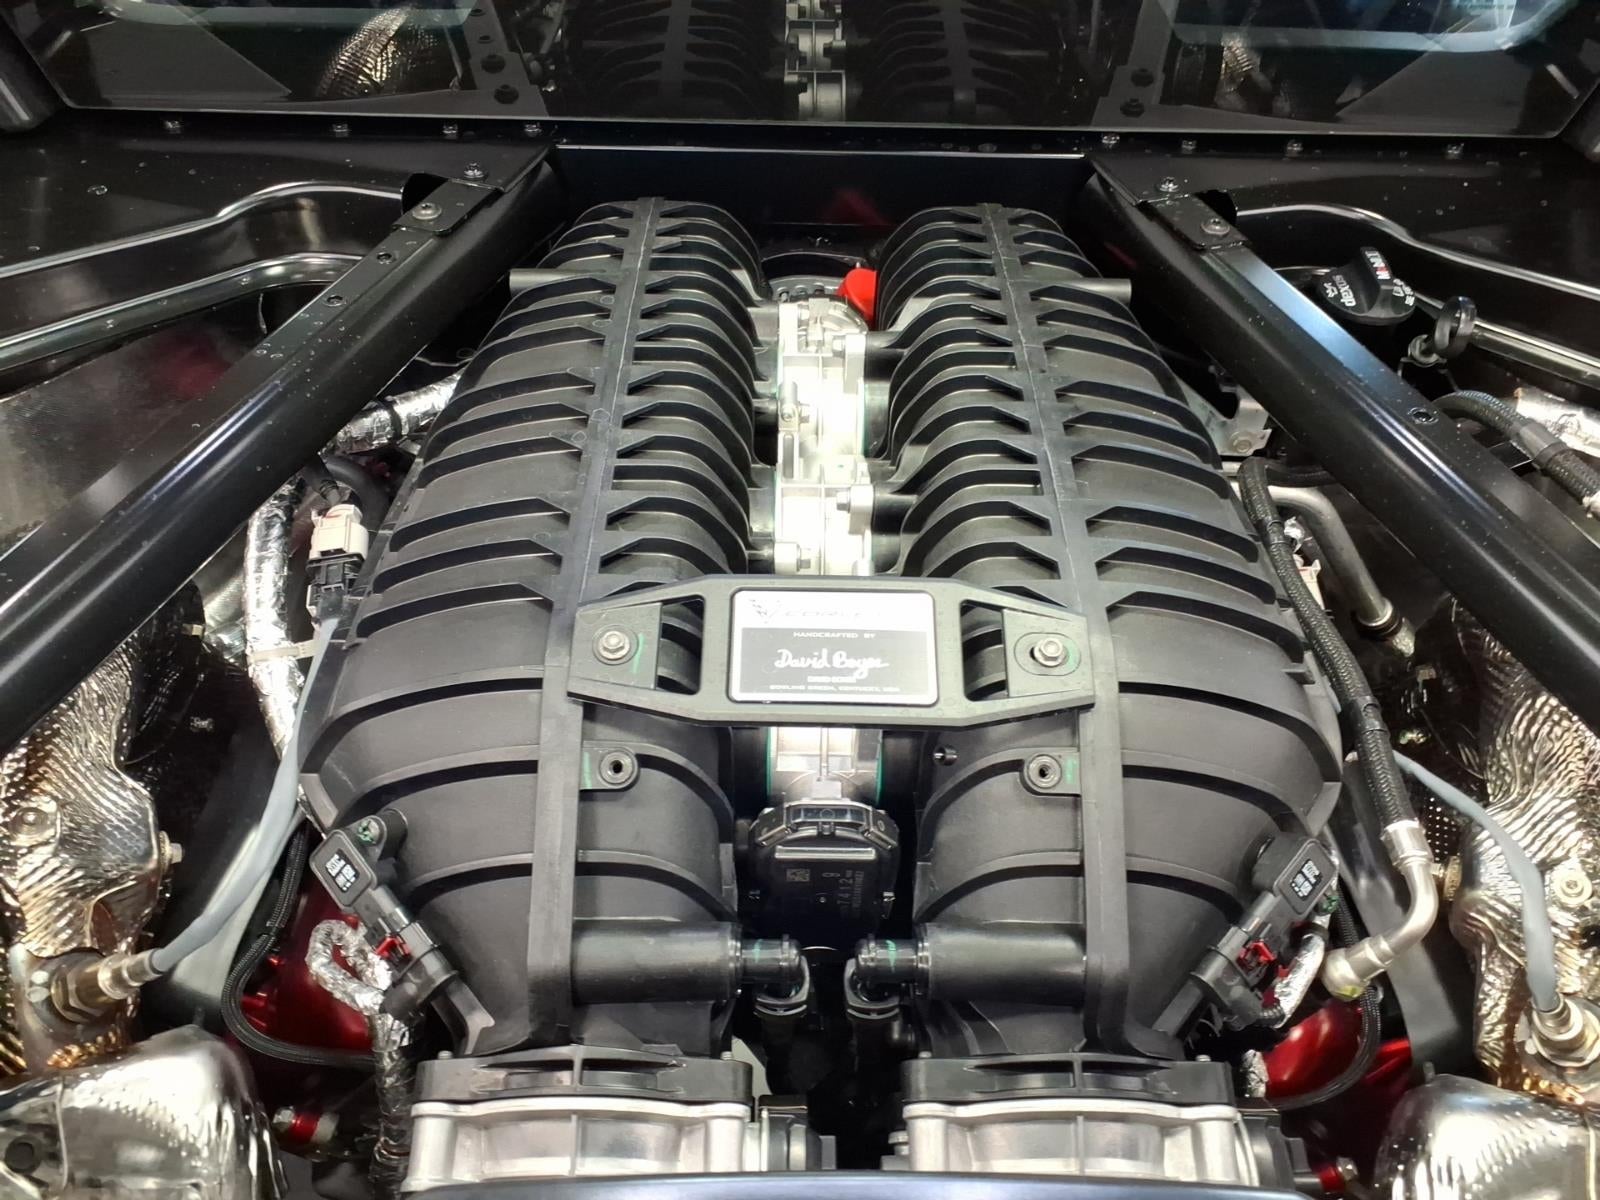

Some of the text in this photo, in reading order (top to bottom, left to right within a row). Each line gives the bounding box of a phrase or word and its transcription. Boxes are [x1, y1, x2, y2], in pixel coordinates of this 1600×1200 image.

[1332, 275, 1356, 307] dexos
[793, 631, 858, 639] HANDCRAFTED
[774, 648, 831, 669] David
